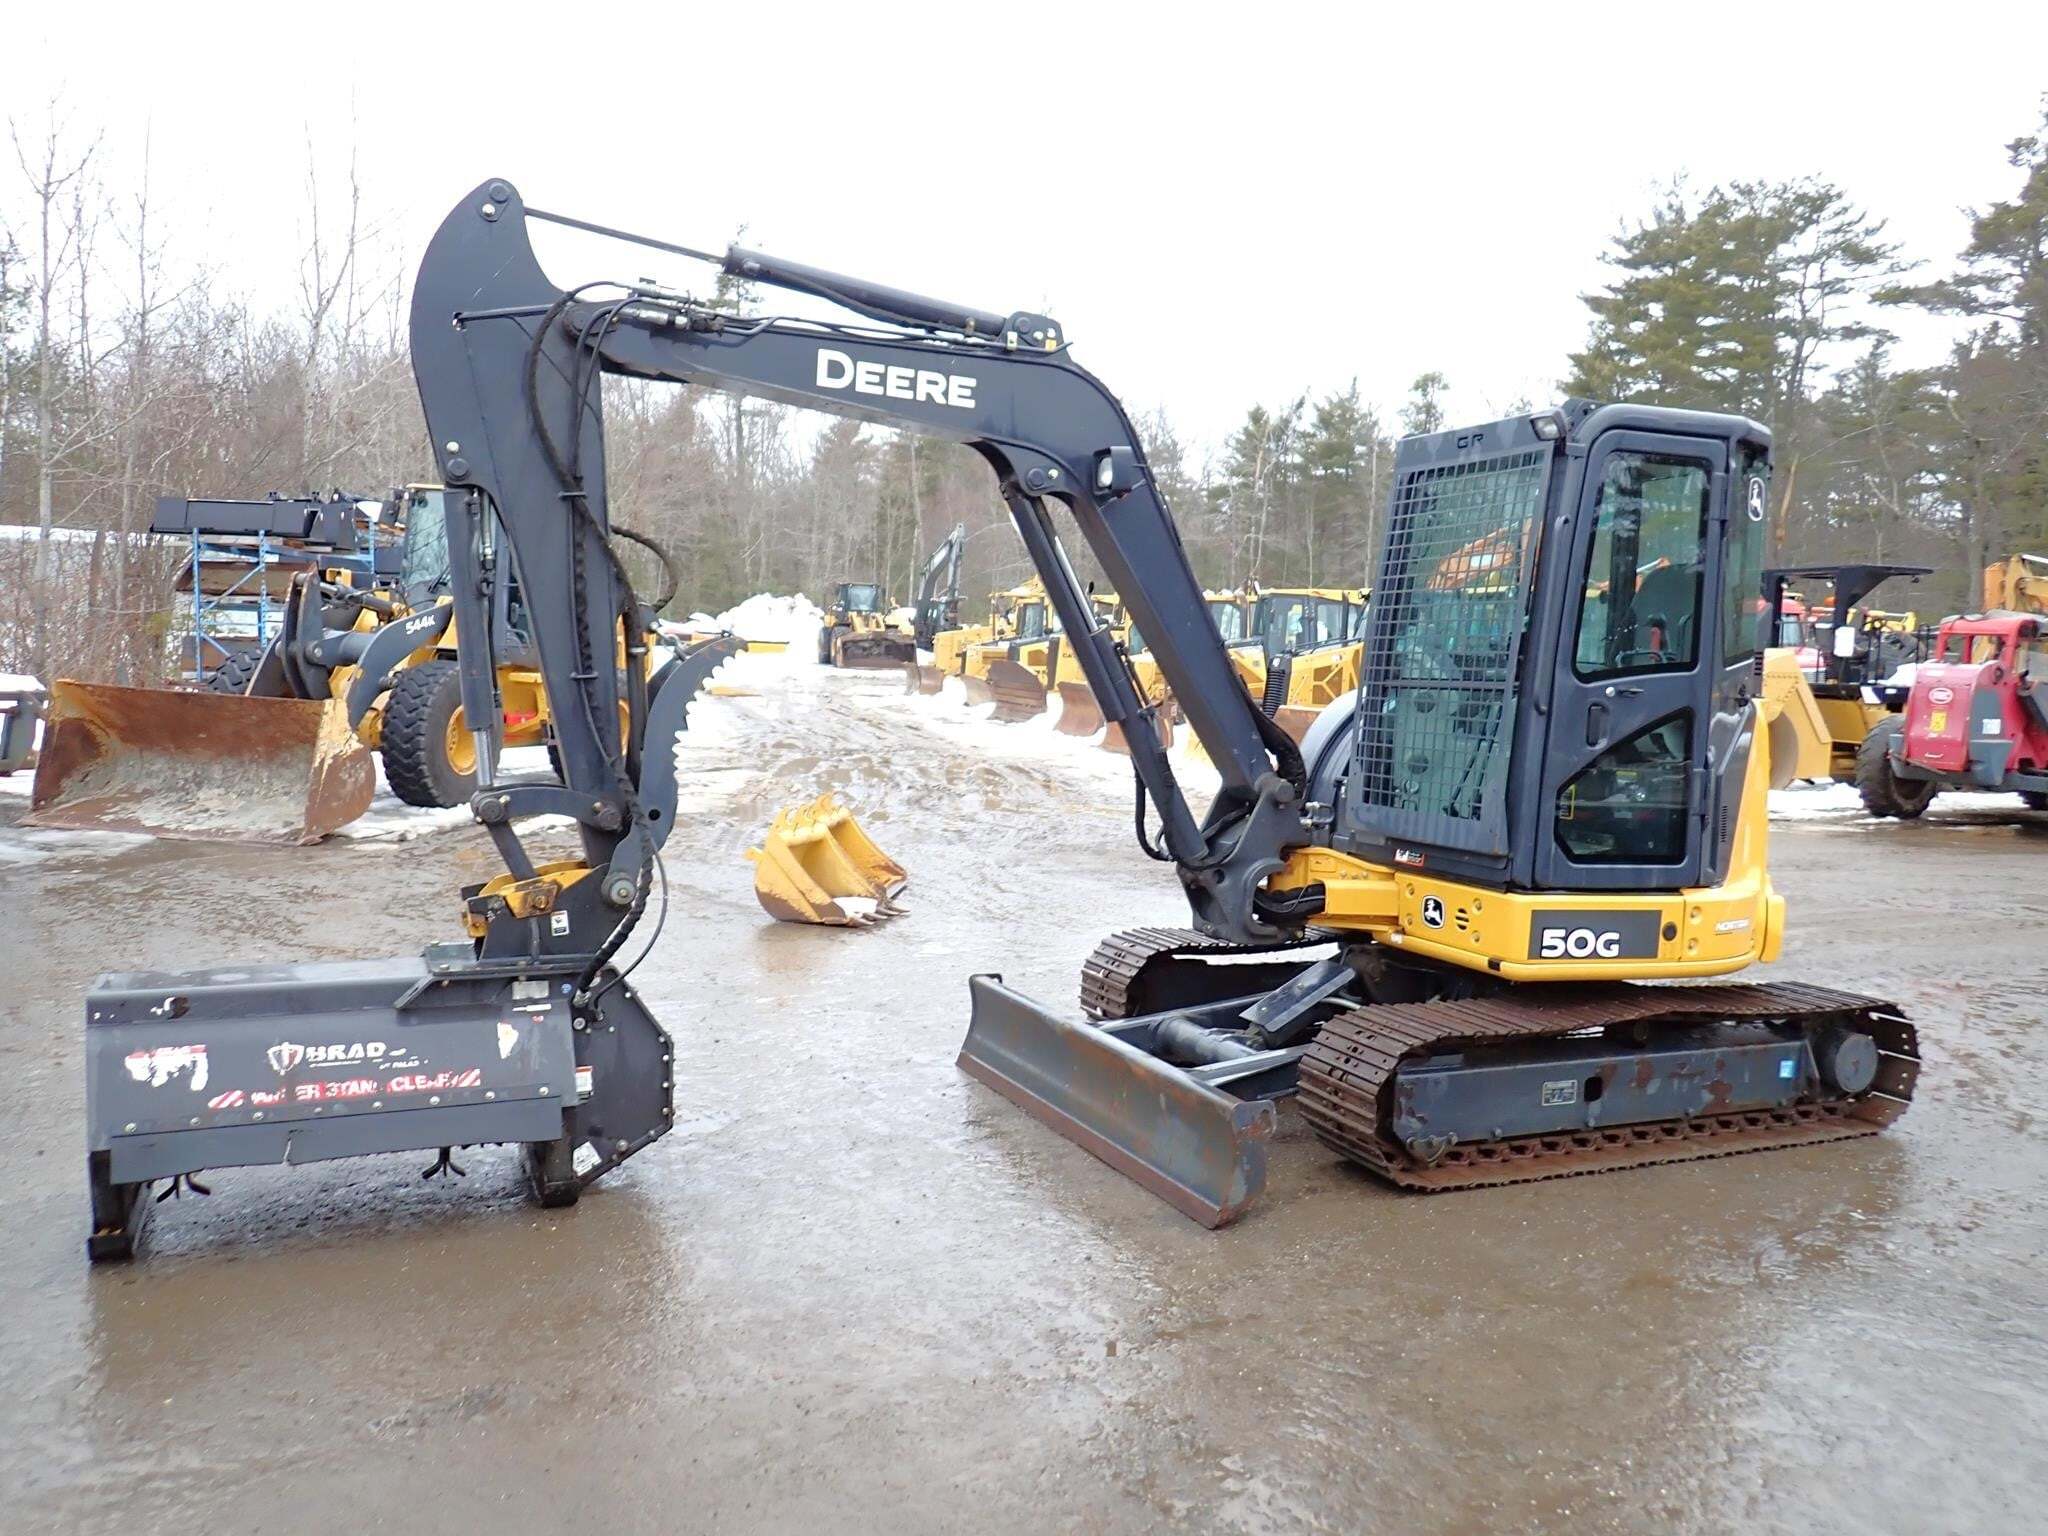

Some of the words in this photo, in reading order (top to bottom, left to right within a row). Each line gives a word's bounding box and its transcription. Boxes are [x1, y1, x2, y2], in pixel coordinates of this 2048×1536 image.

[816, 348, 977, 408] DEERE
[405, 614, 436, 635] 544K
[1540, 928, 1621, 958] 50G
